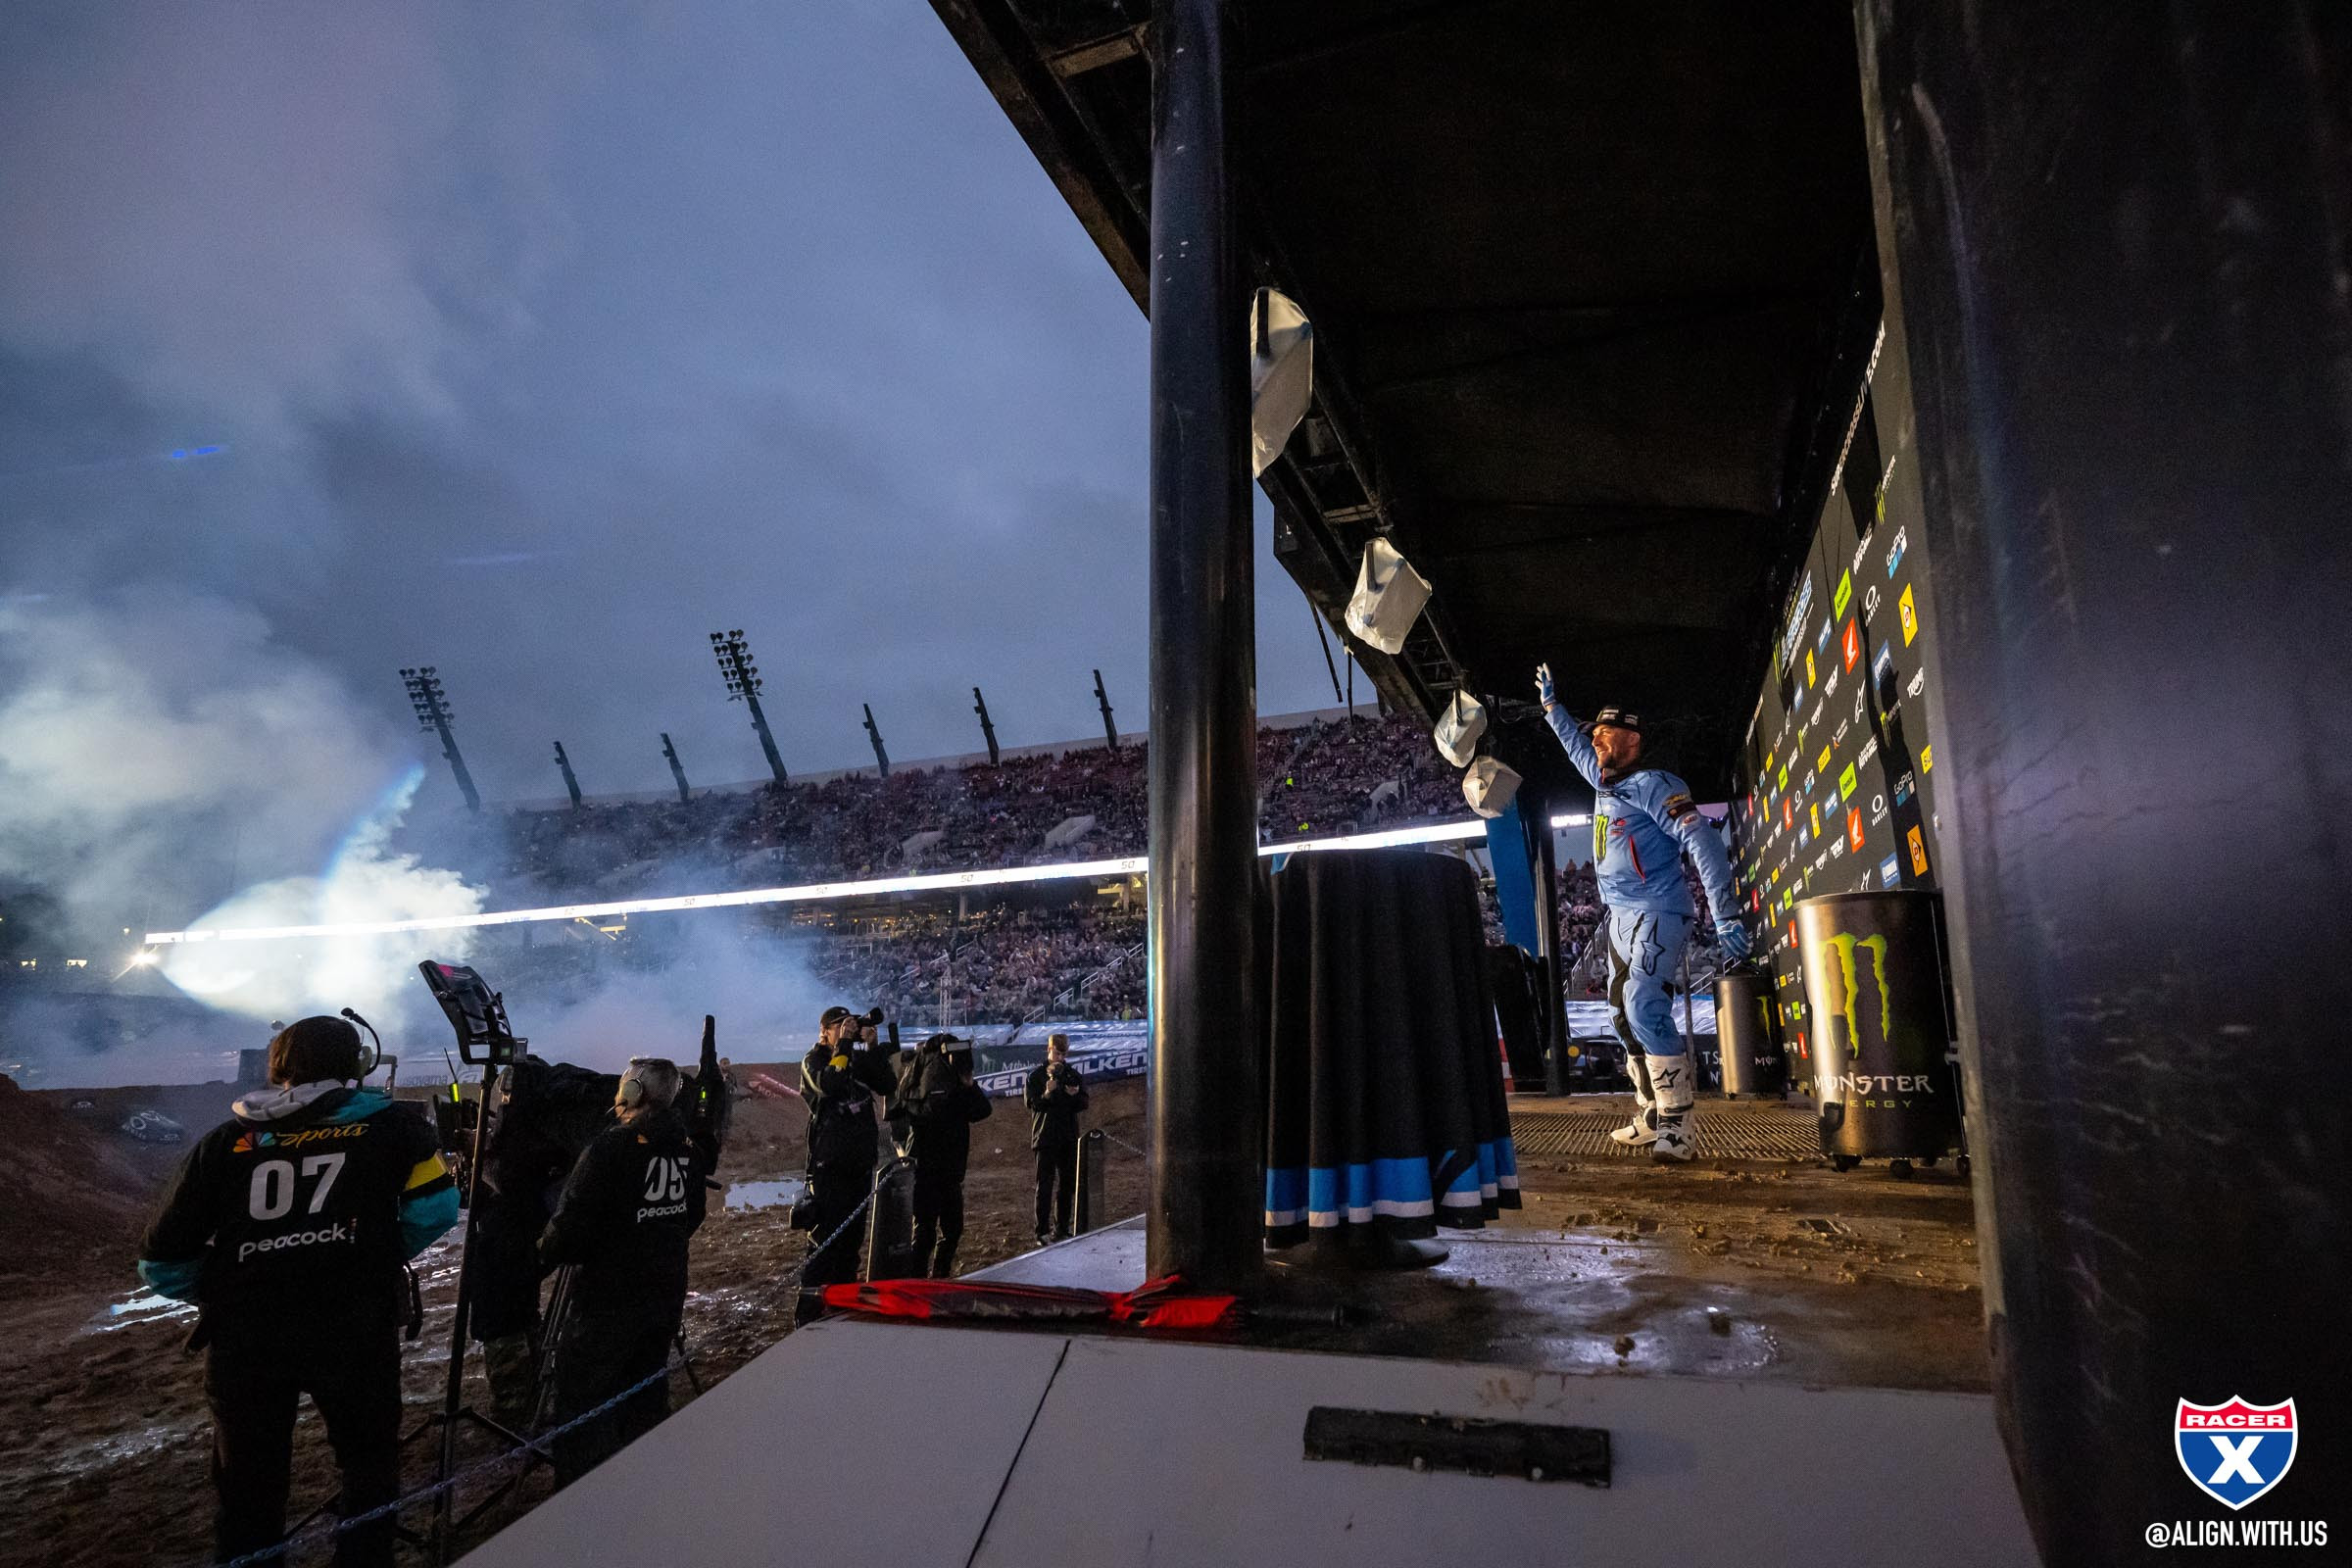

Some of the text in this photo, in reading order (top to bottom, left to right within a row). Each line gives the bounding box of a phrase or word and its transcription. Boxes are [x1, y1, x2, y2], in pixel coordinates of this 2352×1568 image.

[1831, 319, 1886, 497] SUPERCROSSLIVE.COM
[1886, 524, 1905, 566] GoPro
[1893, 770, 1913, 795] GoPro
[1071, 1052, 1148, 1075] ALKEN
[977, 1071, 1028, 1092] KEN
[1004, 1087, 1024, 1098] TIRE
[1813, 1070, 1936, 1096] MONSTER
[275, 1123, 369, 1149] Sports
[249, 1152, 347, 1221] 07
[643, 1155, 691, 1201] 05
[237, 1222, 348, 1263] peacock
